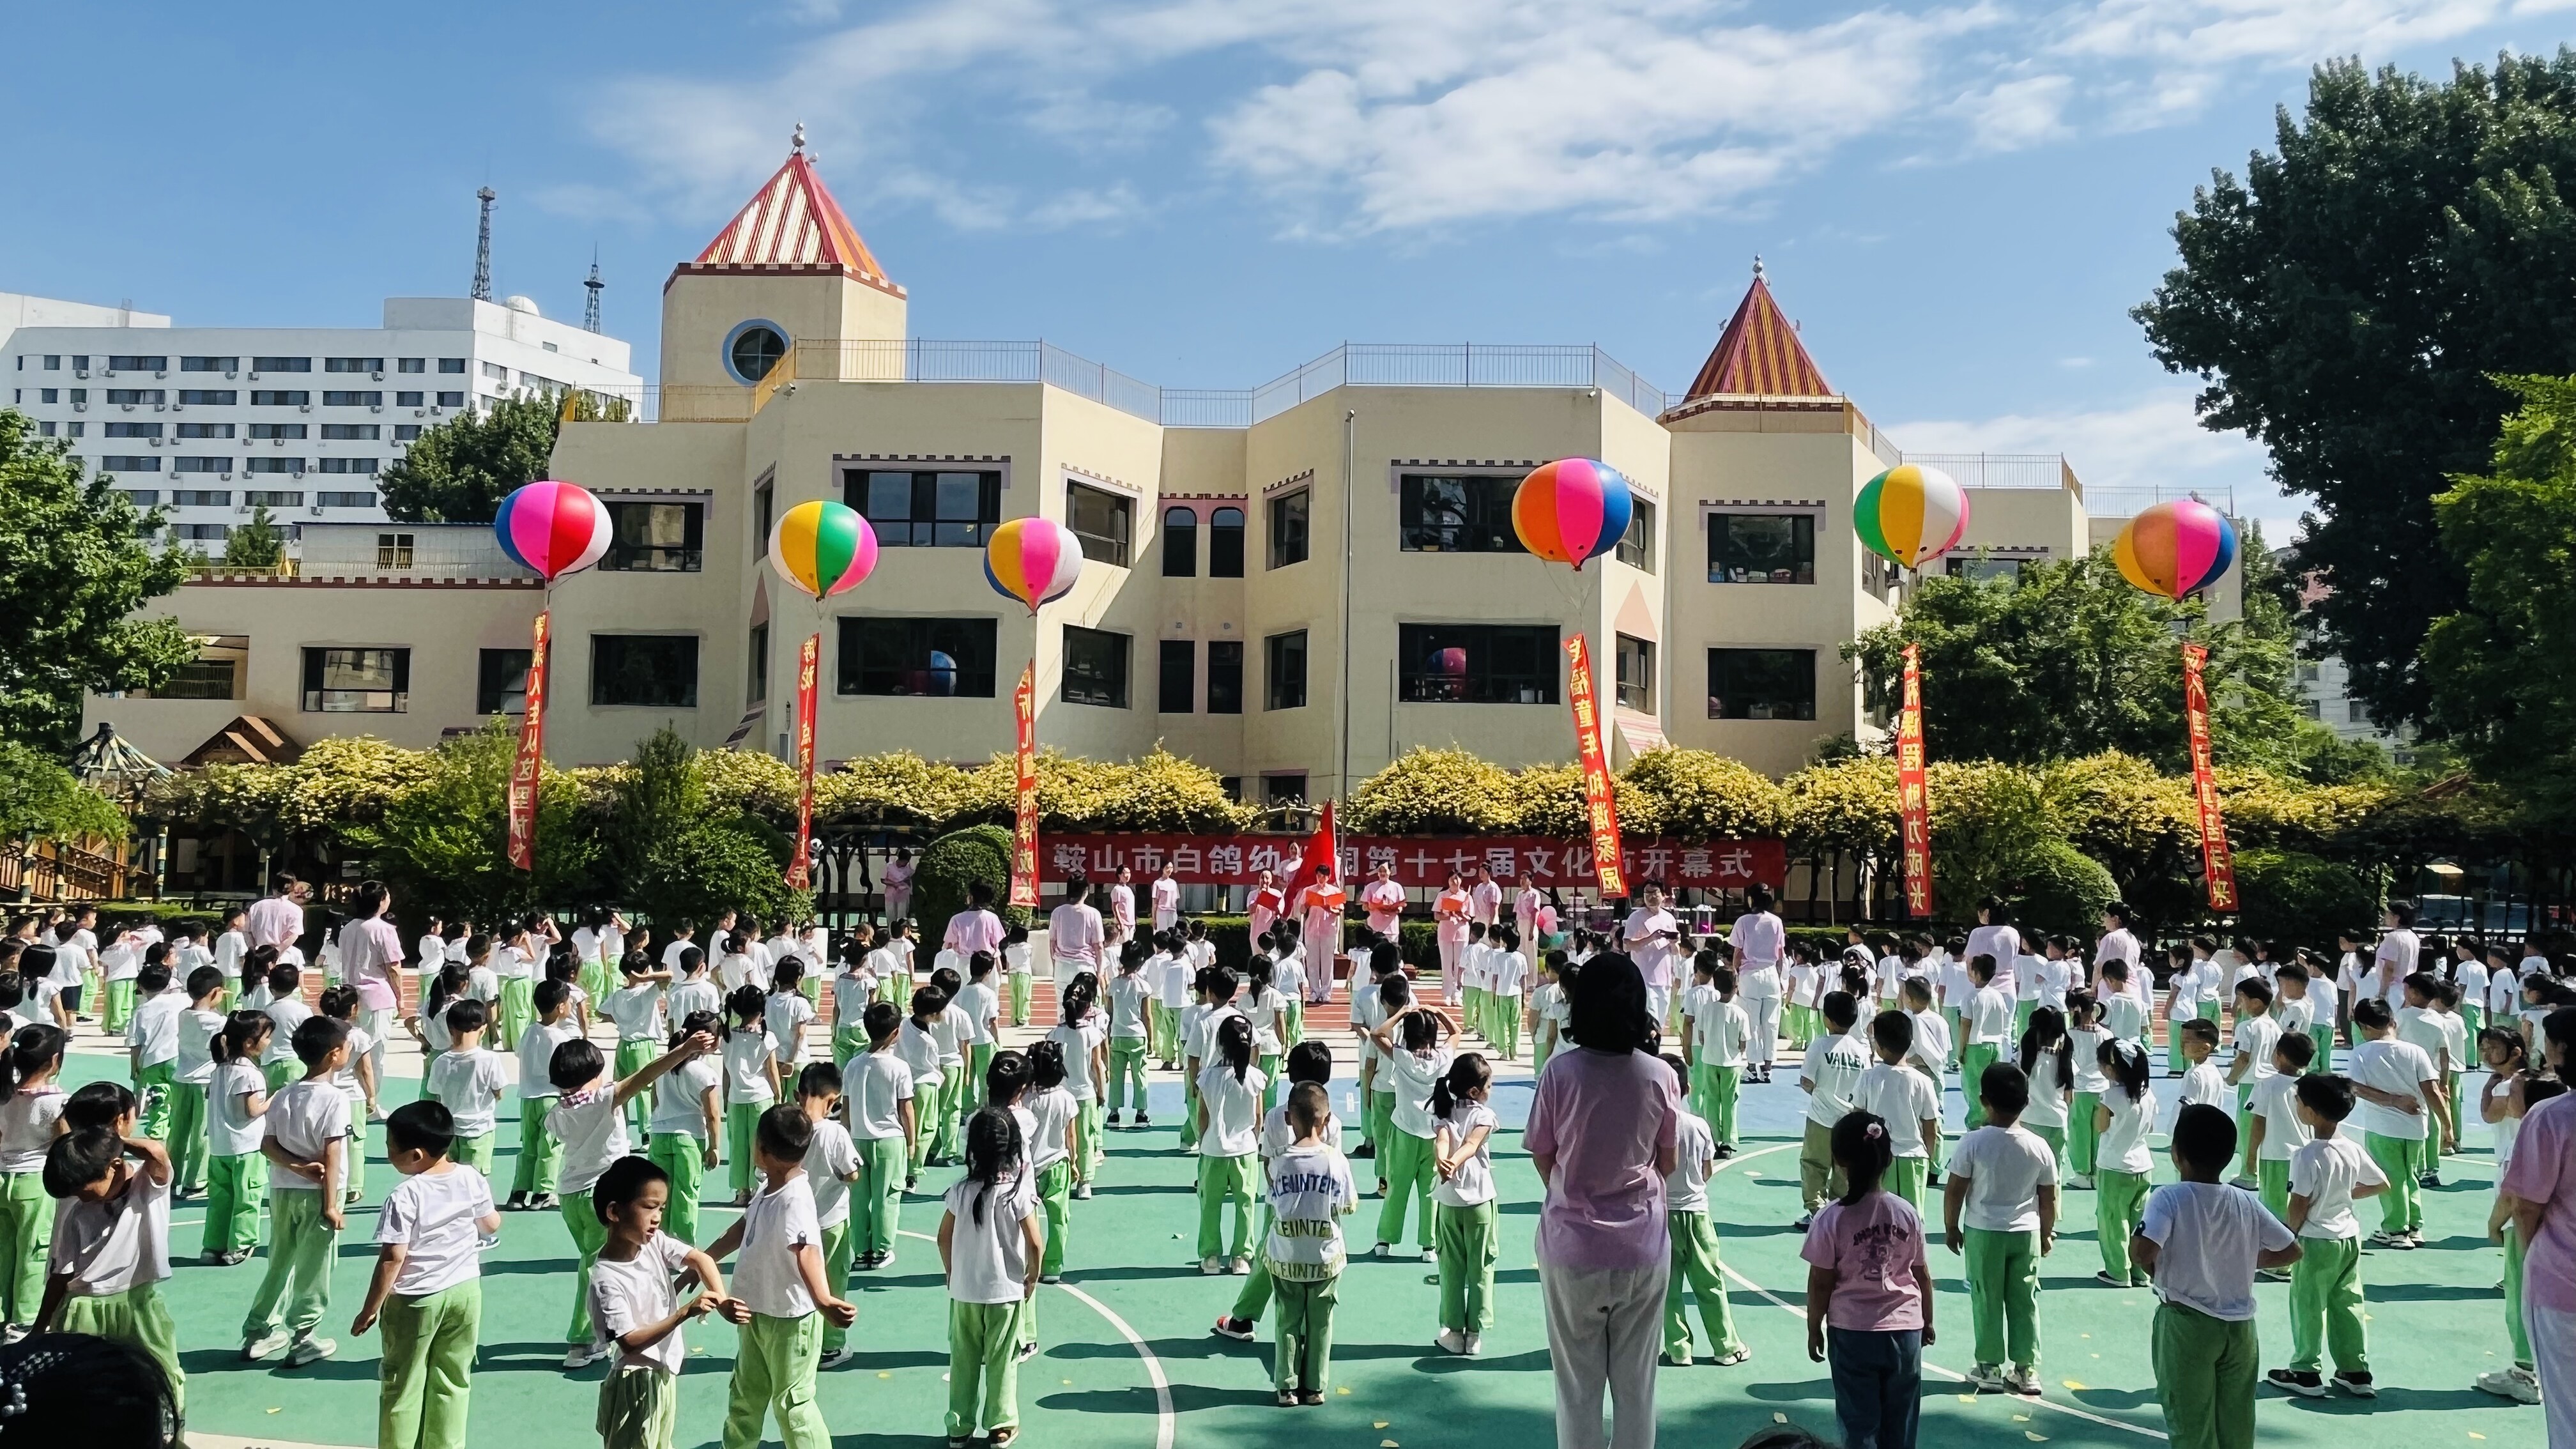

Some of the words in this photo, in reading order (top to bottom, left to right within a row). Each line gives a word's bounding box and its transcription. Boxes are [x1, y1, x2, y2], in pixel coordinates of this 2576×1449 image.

[1054, 843, 1752, 878] 鞍山市白鸽幼第十七届文化开幕式
[1825, 1052, 1864, 1070] VALLE
